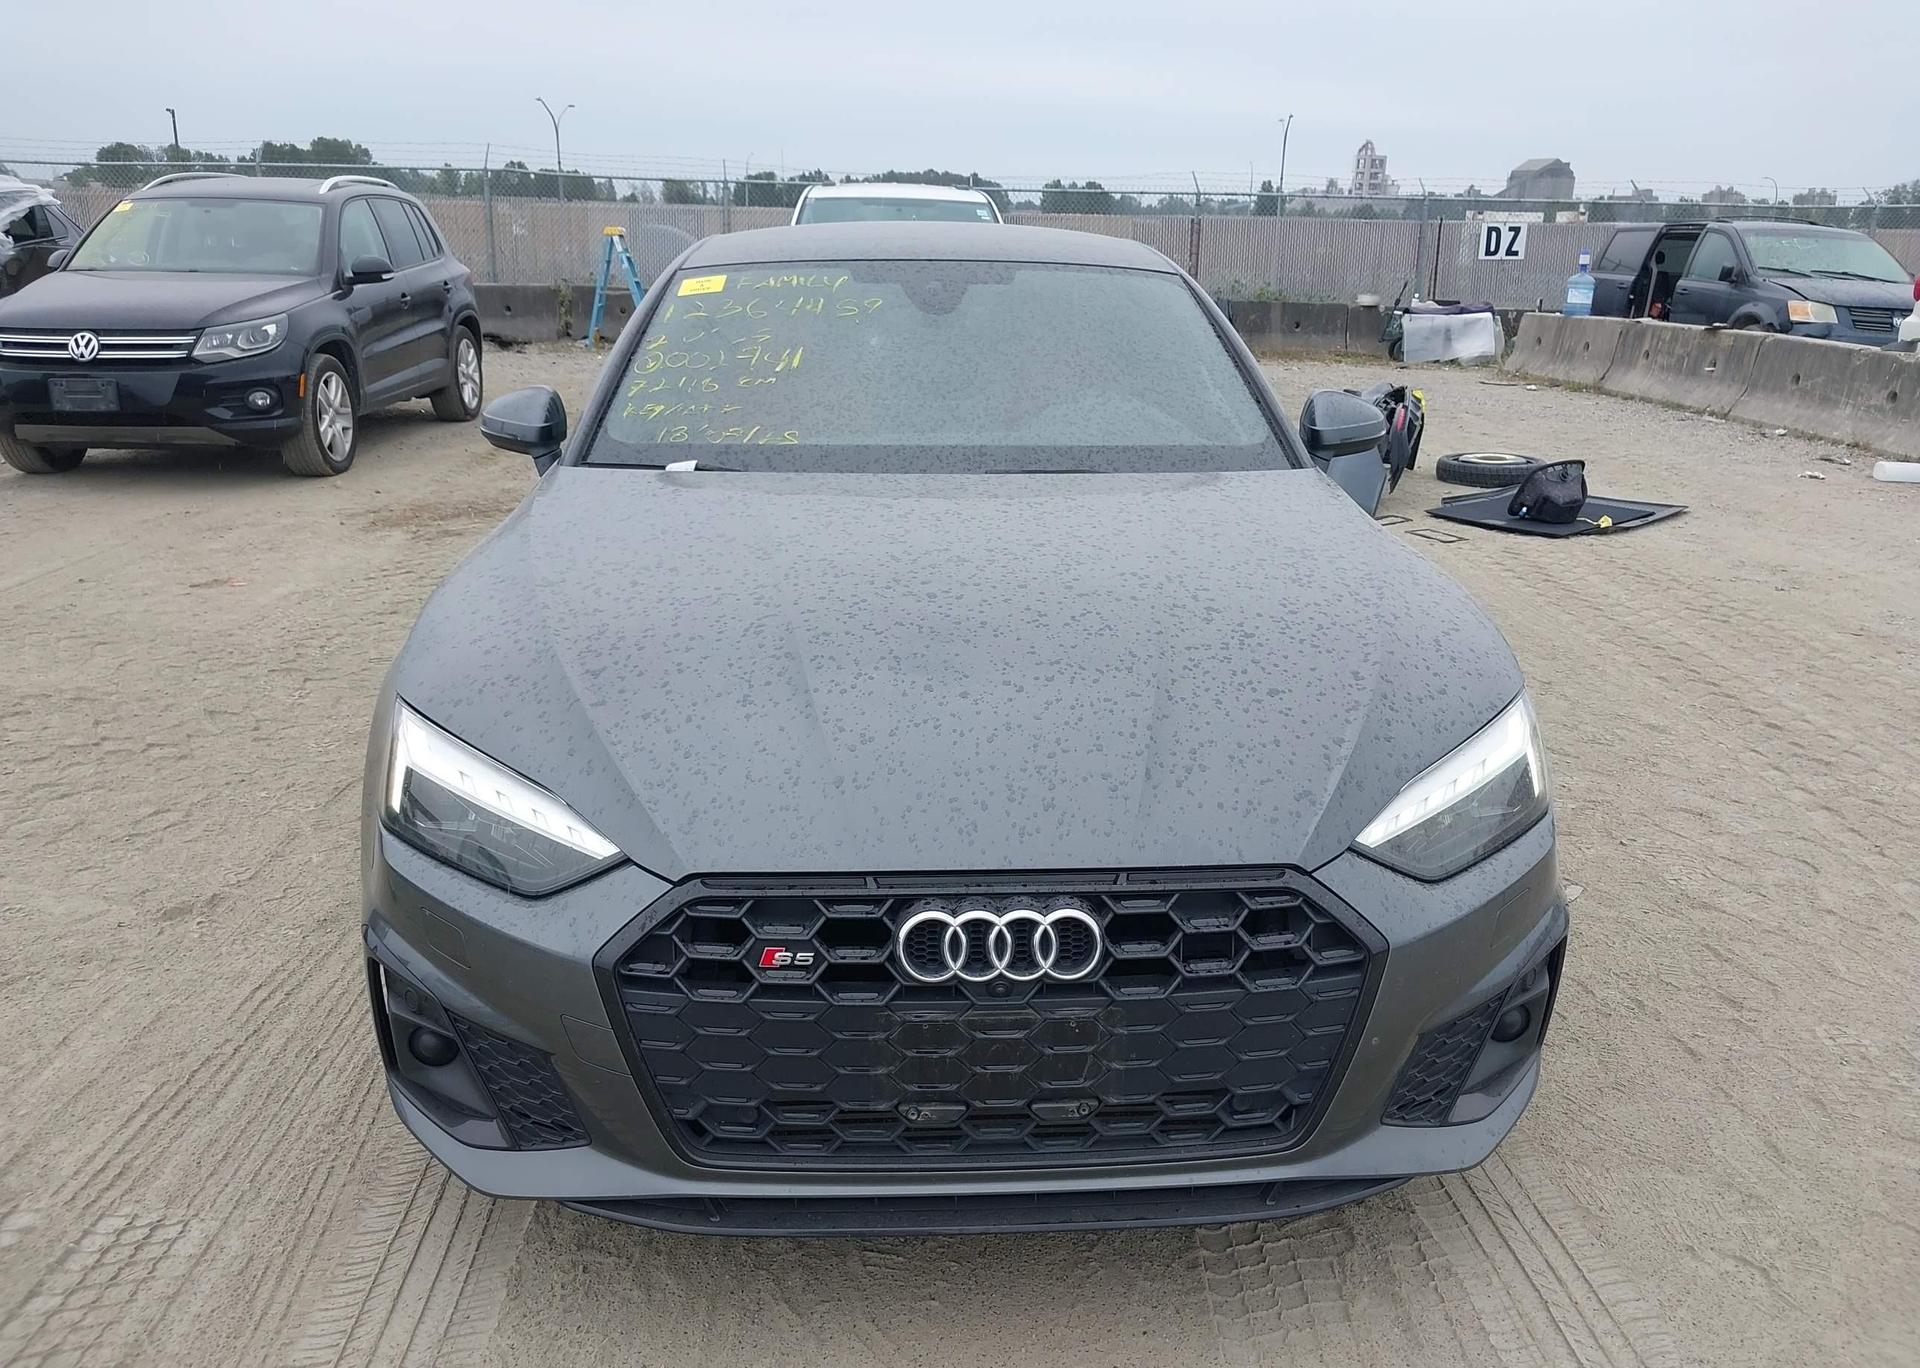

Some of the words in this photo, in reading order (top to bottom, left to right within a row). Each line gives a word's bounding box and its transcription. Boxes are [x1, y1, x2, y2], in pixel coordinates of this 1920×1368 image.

[1484, 226, 1521, 257] DZ
[68, 332, 99, 361] VW
[771, 951, 815, 966] S5
